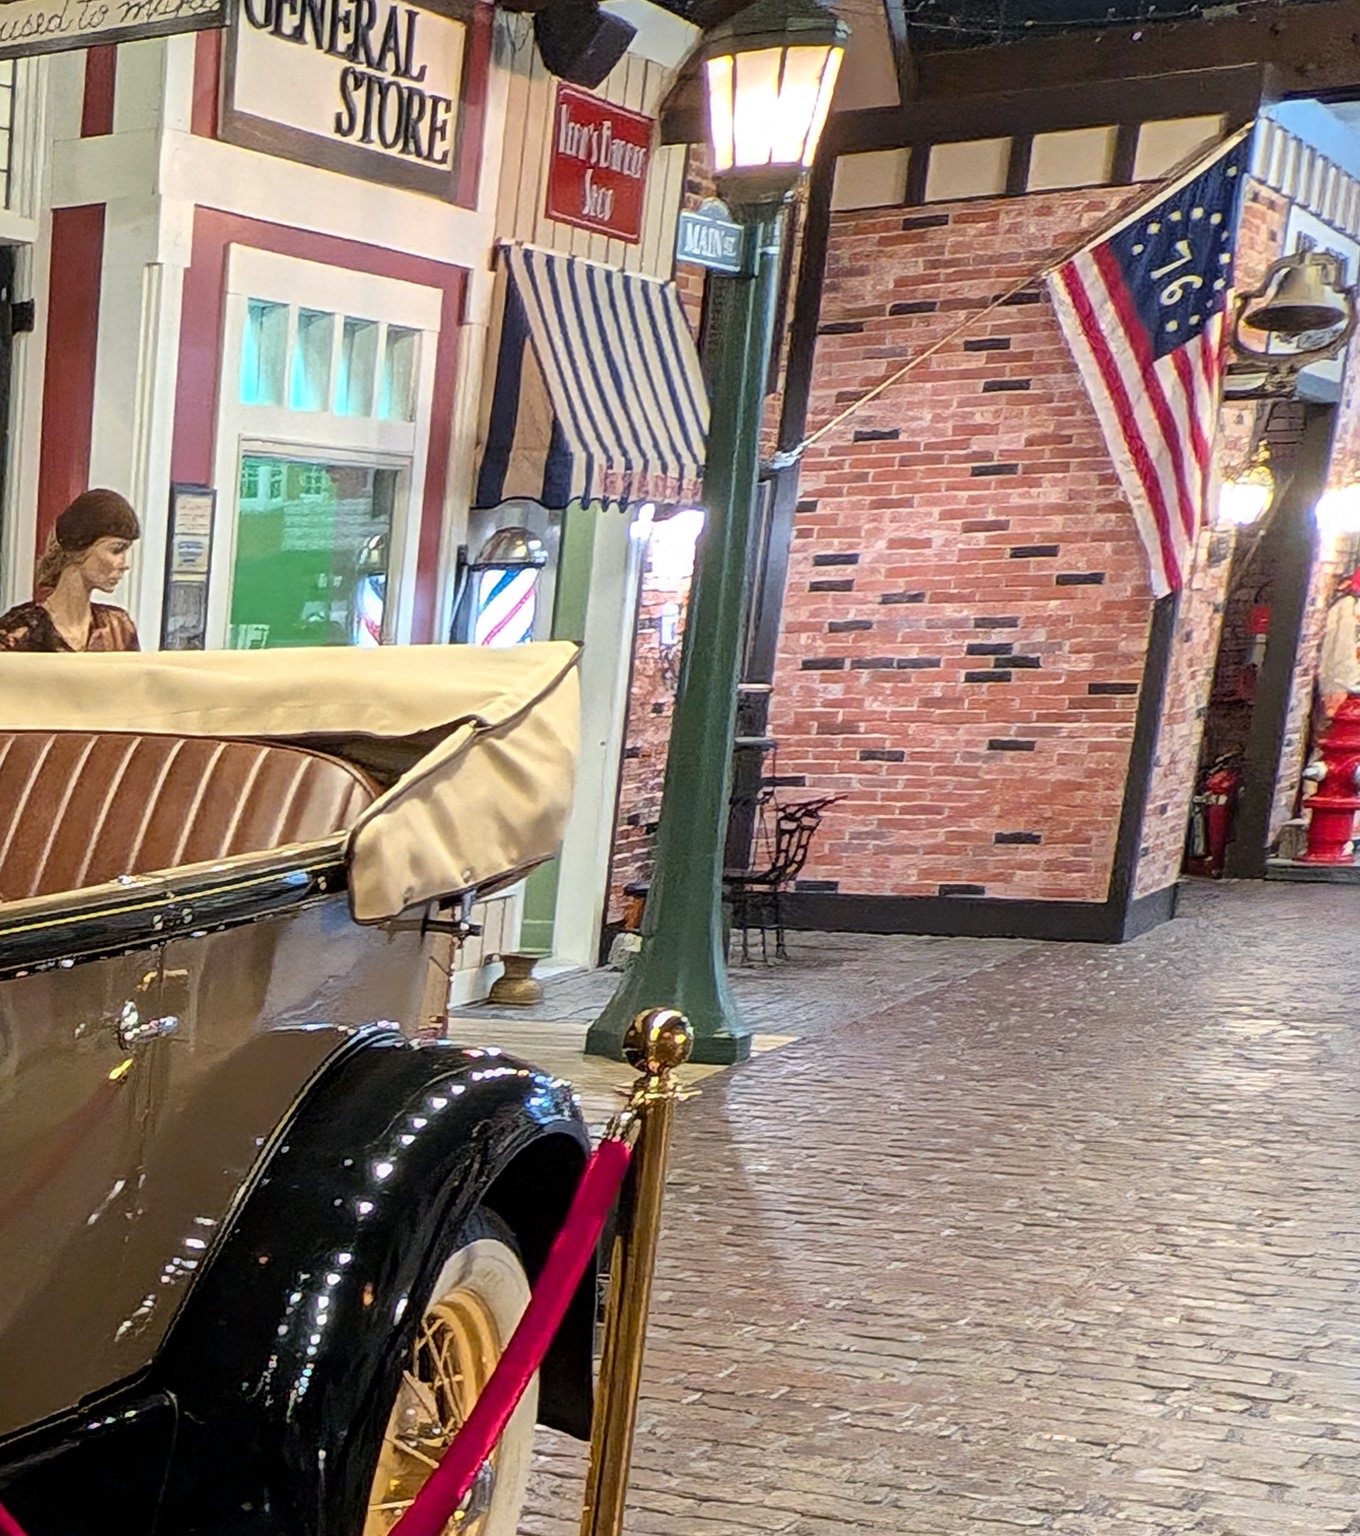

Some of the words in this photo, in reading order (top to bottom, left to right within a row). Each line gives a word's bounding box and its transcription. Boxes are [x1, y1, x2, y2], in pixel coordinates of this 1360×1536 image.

[77, 0, 109, 29] to
[334, 66, 452, 164] STORE
[684, 222, 725, 257] MAIN
[1150, 239, 1204, 306] 76
